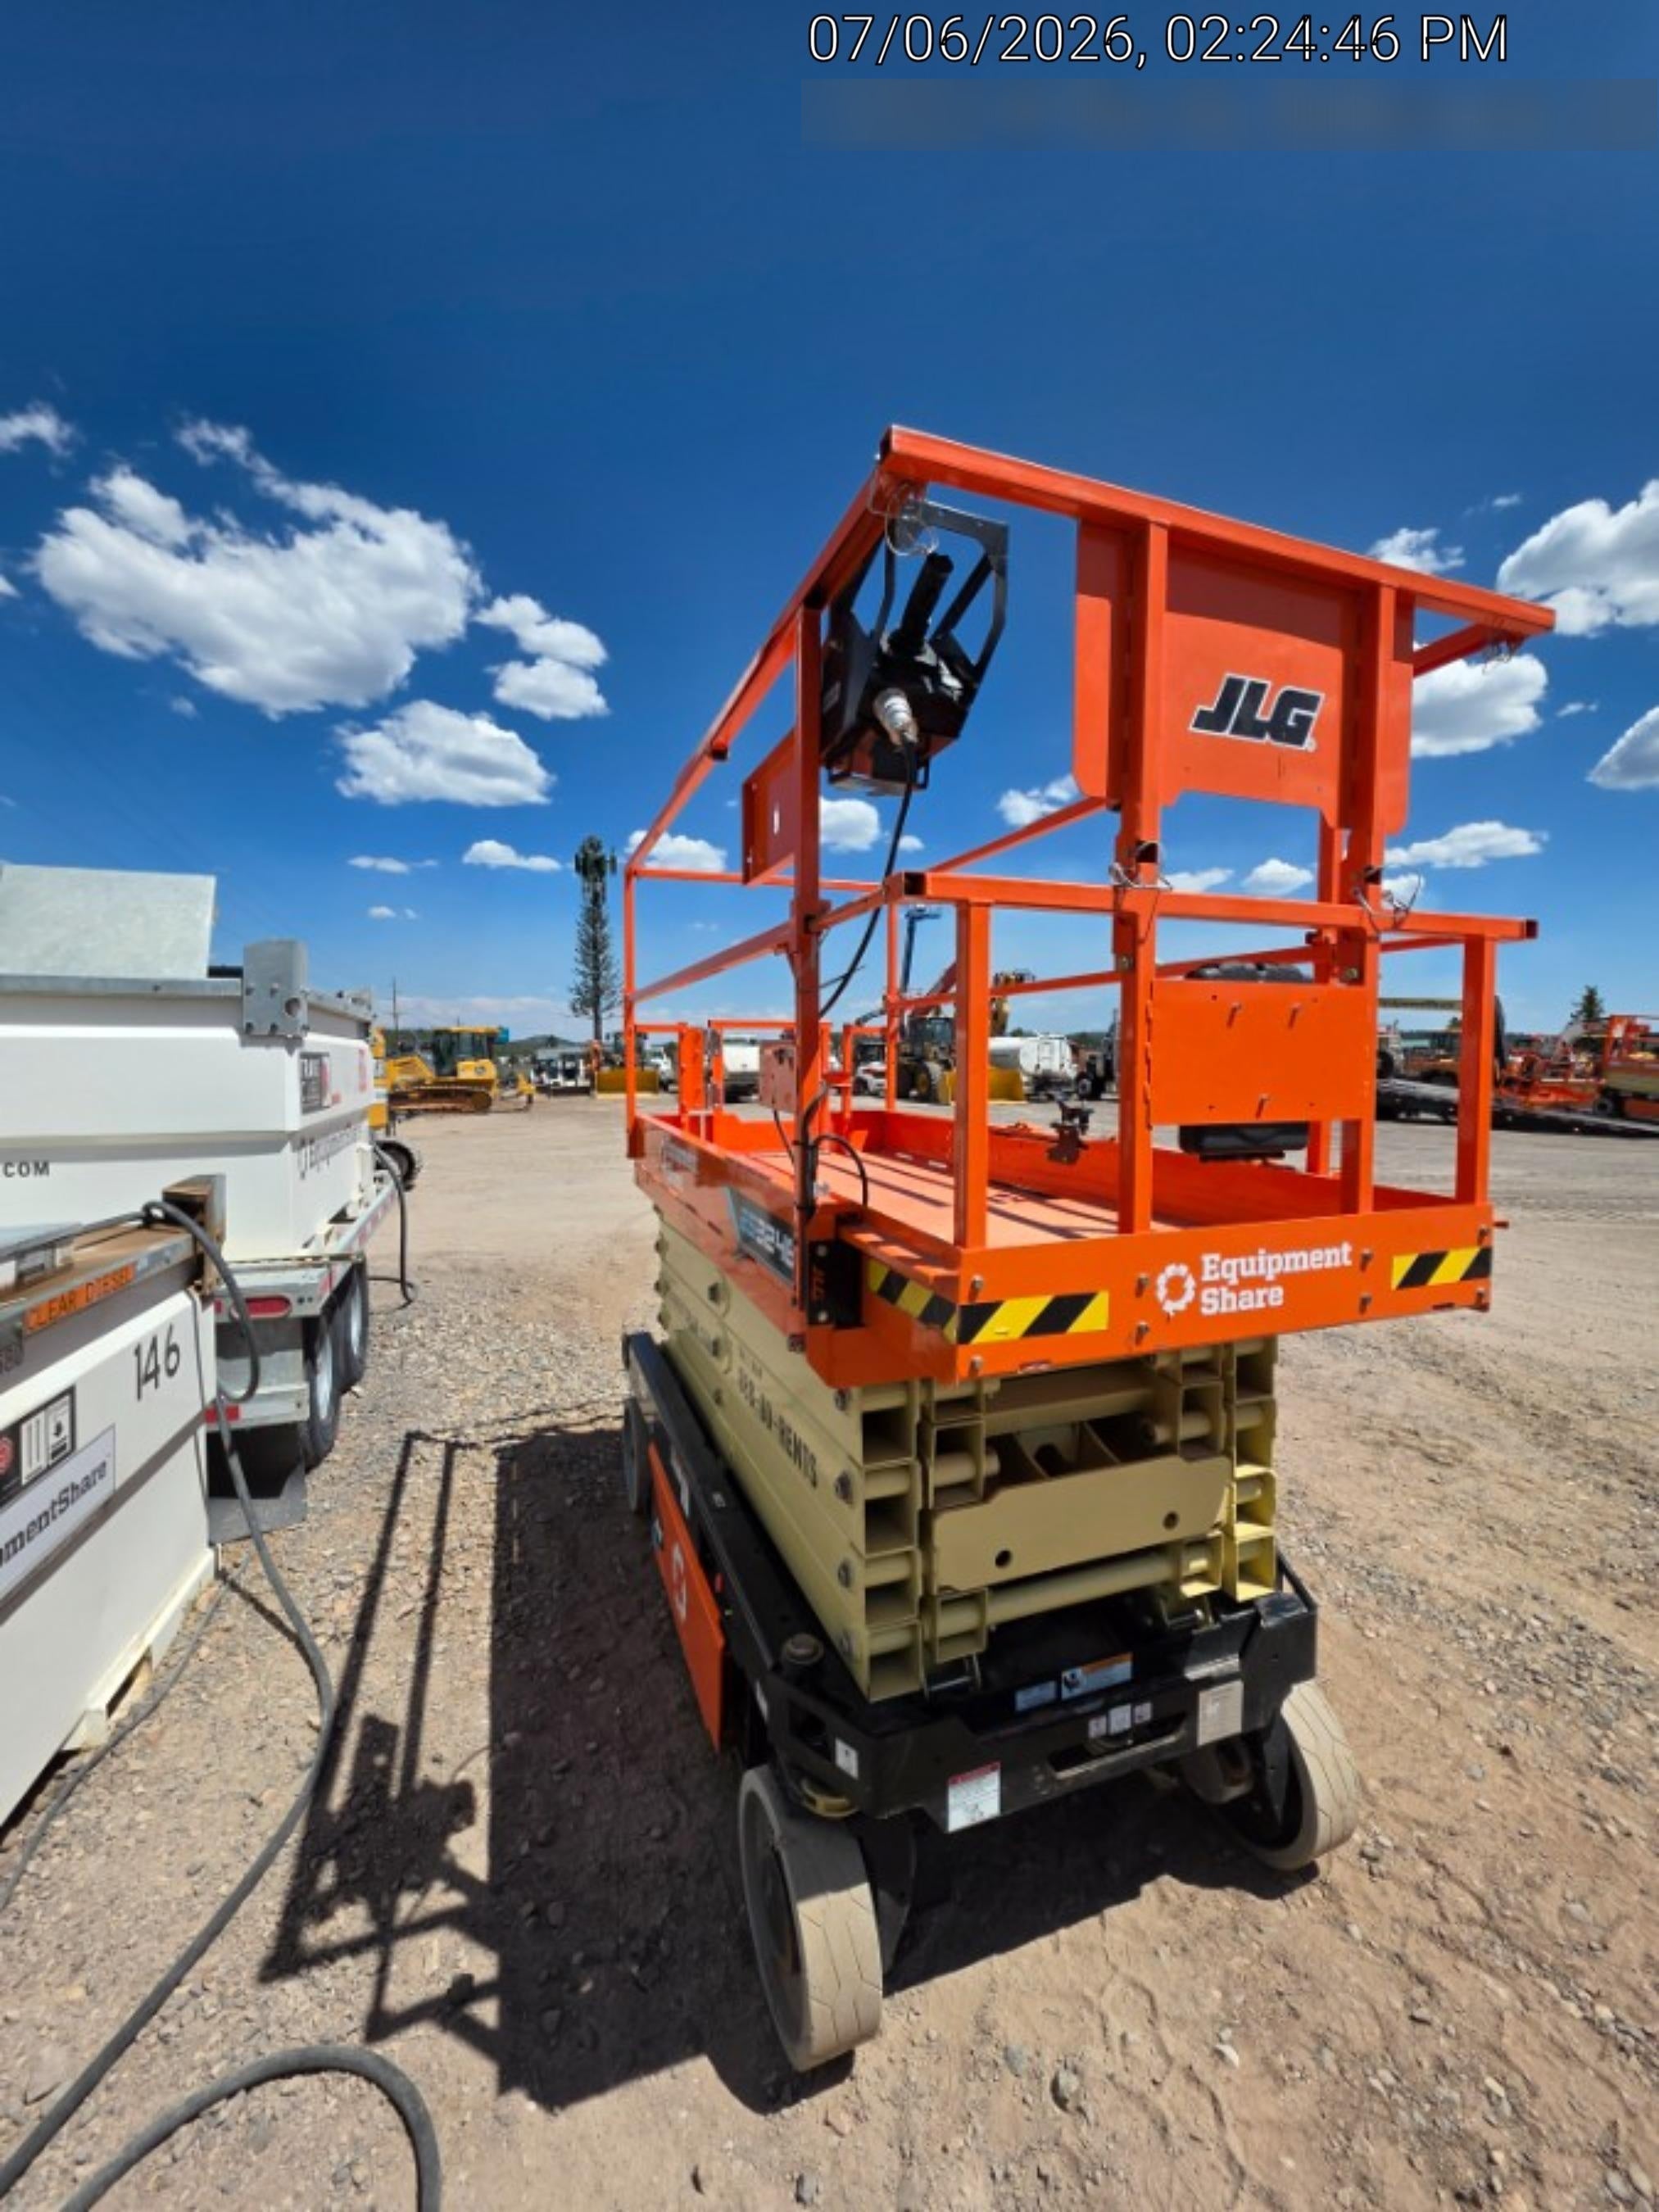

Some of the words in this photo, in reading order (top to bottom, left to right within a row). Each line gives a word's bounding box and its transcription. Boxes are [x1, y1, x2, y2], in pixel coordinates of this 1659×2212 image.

[1189, 673, 1325, 751] JLG
[1199, 1240, 1353, 1286] Equipment
[1199, 1285, 1285, 1317] Share
[134, 1322, 180, 1402] 146
